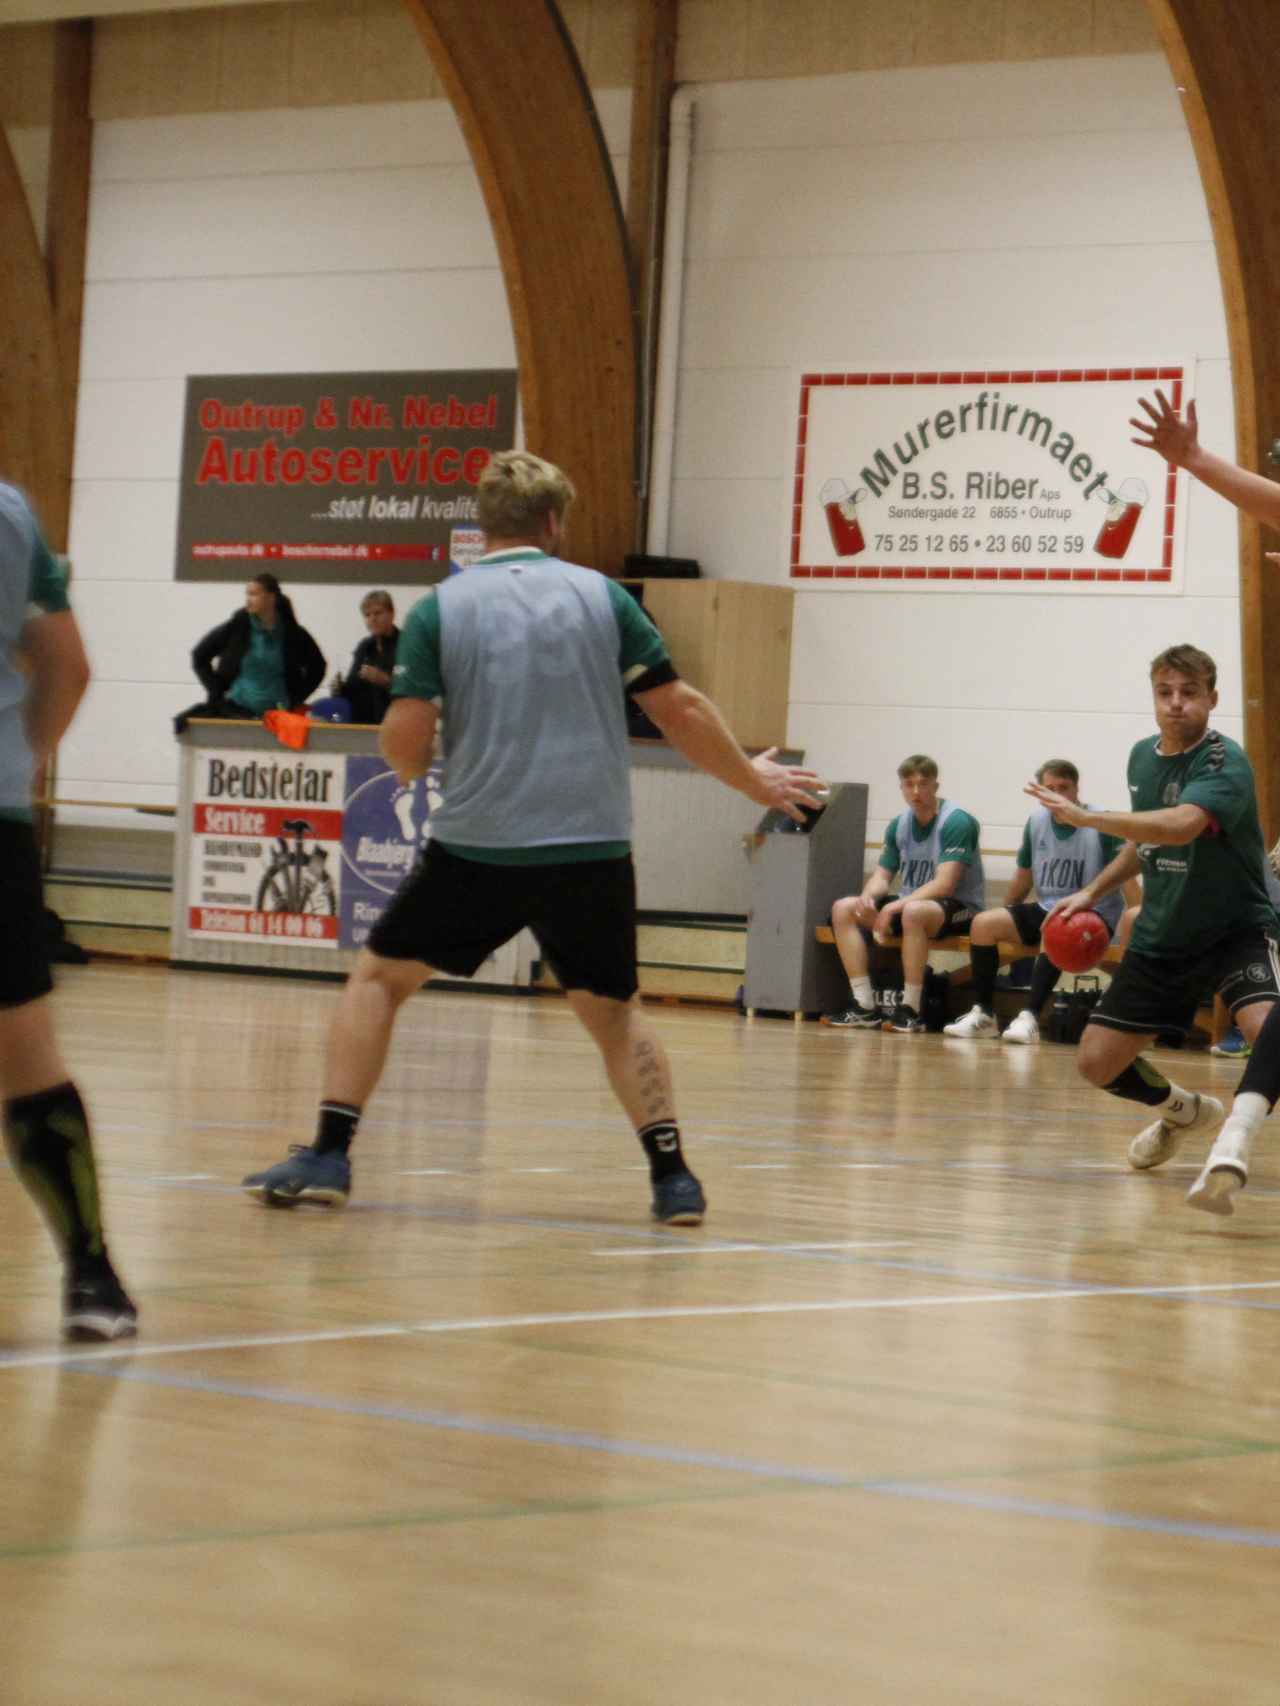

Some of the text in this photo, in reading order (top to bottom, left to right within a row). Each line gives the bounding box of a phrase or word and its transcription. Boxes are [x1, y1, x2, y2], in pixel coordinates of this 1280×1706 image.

[200, 395, 496, 436] Outrup & Nr. Nebel
[859, 391, 1109, 500] Murerfirmaet
[197, 436, 490, 485] Autoservice
[901, 471, 1061, 501] B.S. Riber Aps
[368, 495, 418, 518] lokal
[962, 506, 976, 519] 22
[990, 507, 1018, 520] 6855
[1029, 506, 1073, 522] Outrup
[874, 535, 1084, 553] 75 25 12 65 23 60 52 59
[204, 806, 266, 835] Service
